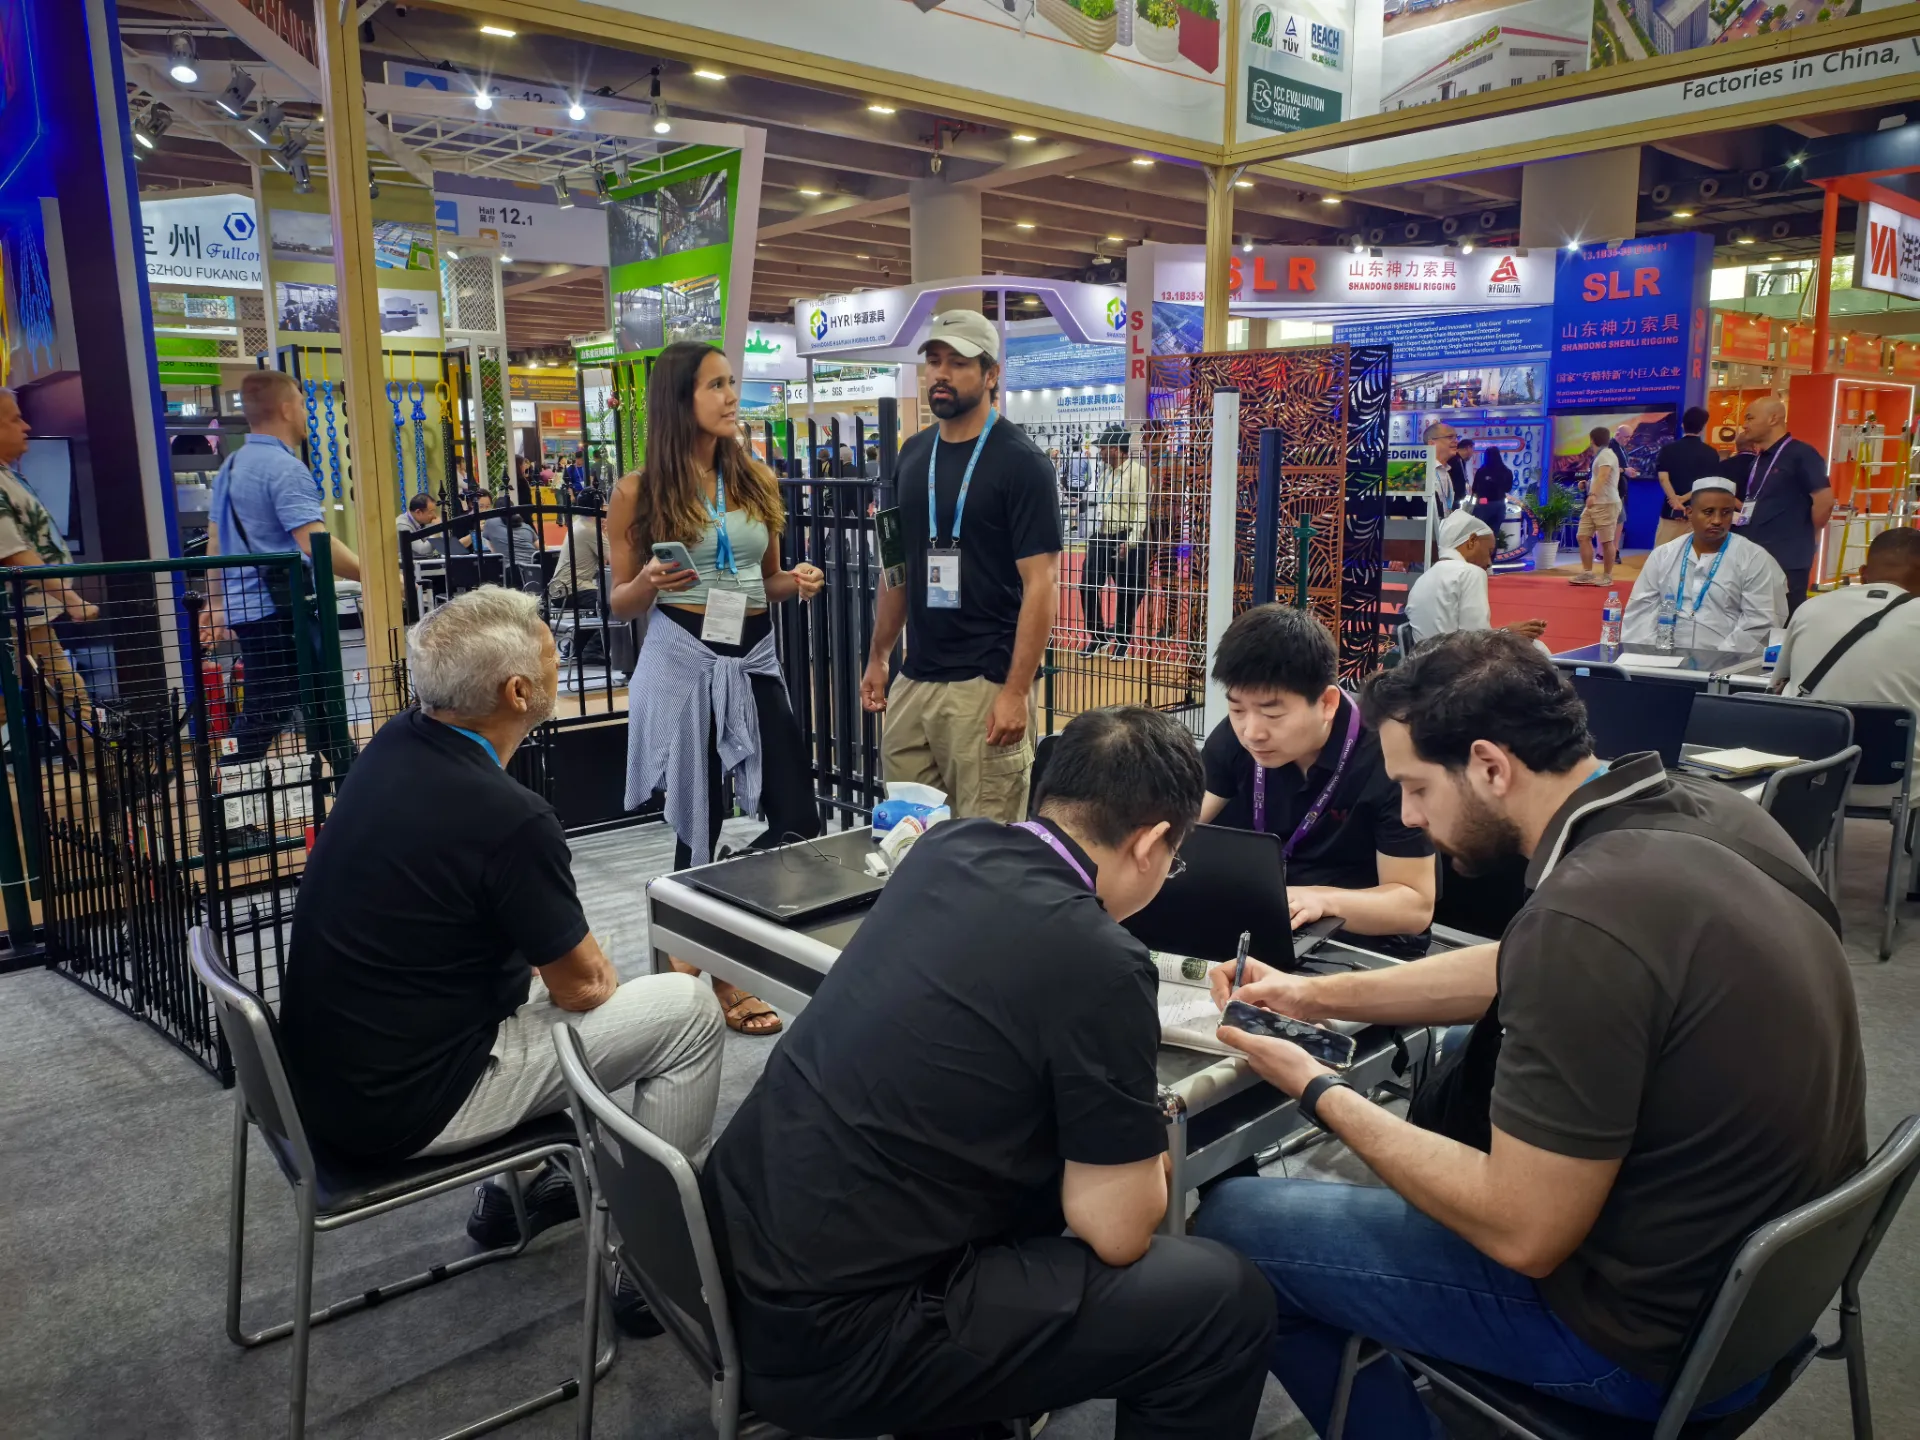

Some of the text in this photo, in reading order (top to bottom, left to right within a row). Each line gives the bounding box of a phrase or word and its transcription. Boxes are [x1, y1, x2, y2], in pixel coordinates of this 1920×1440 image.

[1311, 23, 1340, 50] REACH
[1283, 38, 1299, 54] TÜV
[1683, 47, 1901, 100] Factories in China,
[1274, 85, 1325, 113] ICC EVALUATION
[1273, 102, 1300, 122] SERVICE
[479, 206, 495, 216] Hall
[500, 207, 533, 226] 12.1
[197, 267, 248, 281] FUKANG
[1349, 260, 1457, 278] 山东神力索具
[1348, 282, 1456, 291] SHANDONG SHENLI RIGGING
[1582, 267, 1661, 302] SLR
[830, 315, 850, 329] HYR
[854, 309, 885, 324] 华源索具
[1562, 314, 1680, 339] 山东神力索具
[1130, 310, 1146, 379] SLR
[1561, 336, 1679, 352] SHANDONG SHENLI RIGGING
[832, 387, 843, 396] SGS
